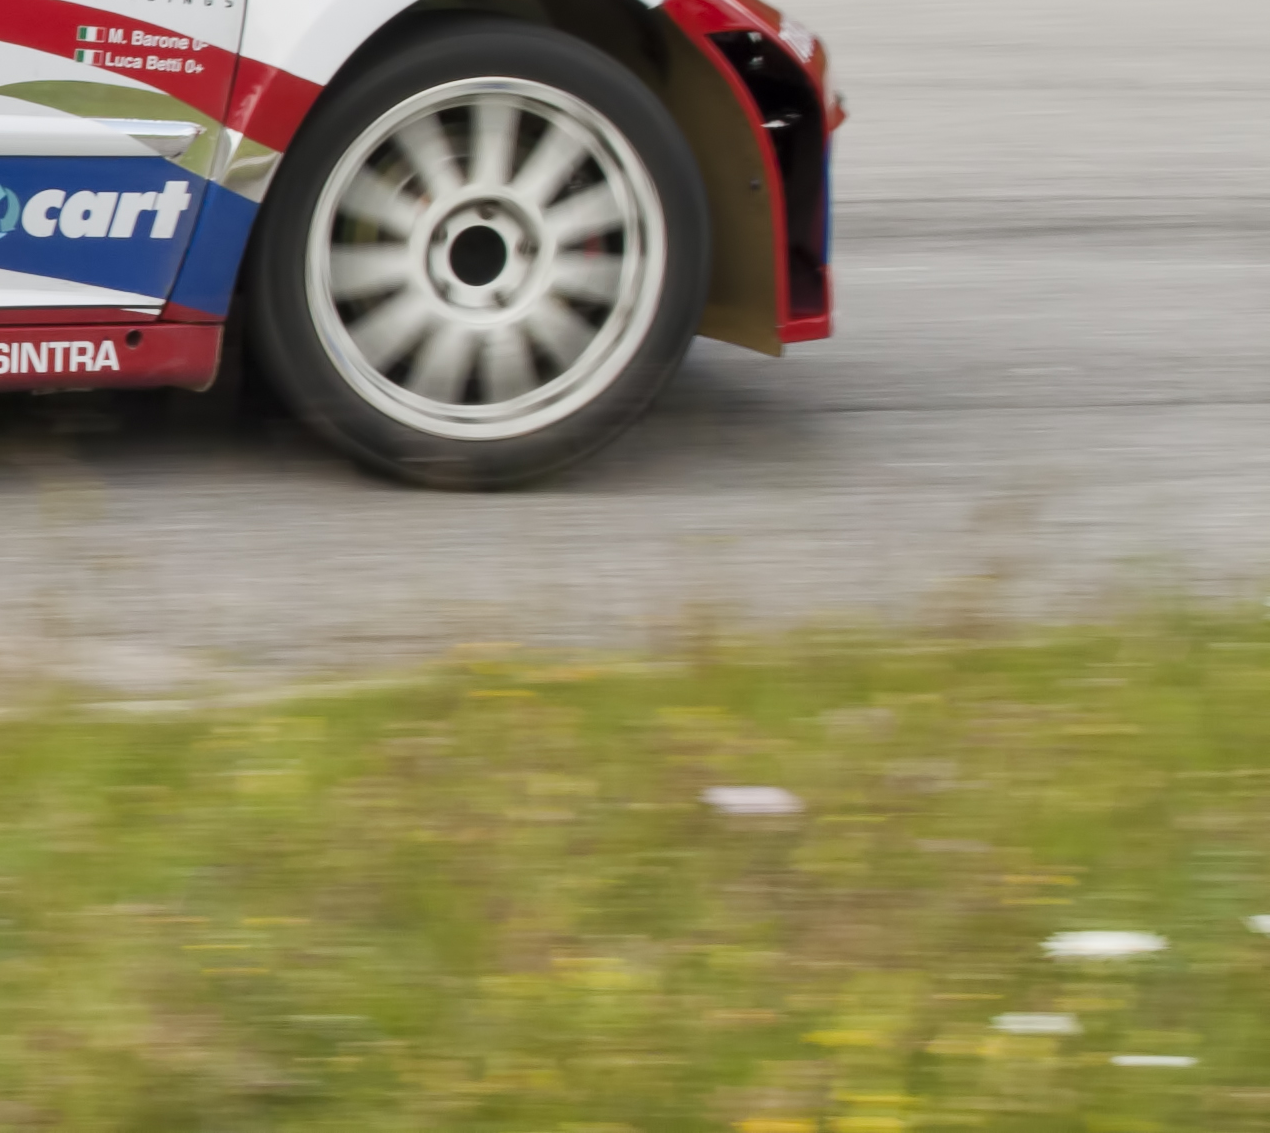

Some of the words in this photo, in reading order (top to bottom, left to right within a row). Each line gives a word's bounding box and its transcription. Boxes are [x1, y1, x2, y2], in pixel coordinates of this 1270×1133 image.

[108, 27, 128, 45] M.
[131, 29, 190, 51] Barone
[104, 52, 143, 69] Luca
[146, 55, 184, 72] Betti
